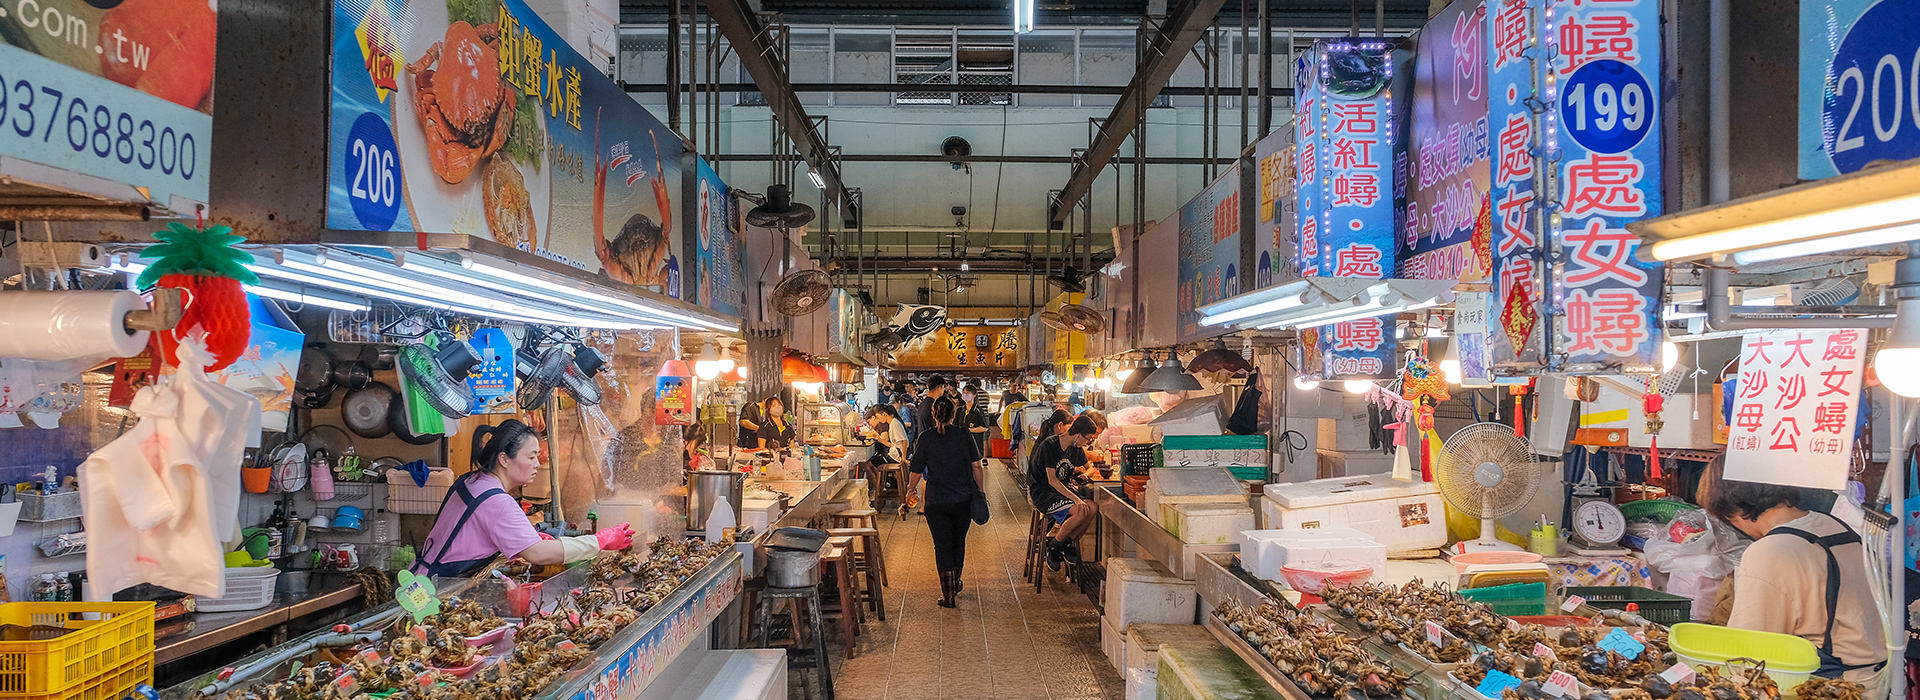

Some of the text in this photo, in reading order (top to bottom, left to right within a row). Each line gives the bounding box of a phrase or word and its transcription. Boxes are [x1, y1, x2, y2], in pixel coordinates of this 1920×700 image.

[499, 5, 583, 133] 鉅蟹水產
[1567, 82, 1646, 132] 199
[1835, 45, 1920, 154] 20
[352, 138, 395, 208] 206
[668, 267, 679, 298] 207
[1563, 154, 1649, 357] 處女蟳
[956, 351, 1005, 366] 生魚片
[1333, 356, 1384, 376] (幼母)
[1736, 336, 1774, 433] 大沙母
[1812, 328, 1859, 434] 處女蟳
[1769, 332, 1814, 453] 大沙公
[1809, 437, 1844, 454] (幼母)
[1534, 644, 1548, 656] 900
[1549, 671, 1571, 688] 900
